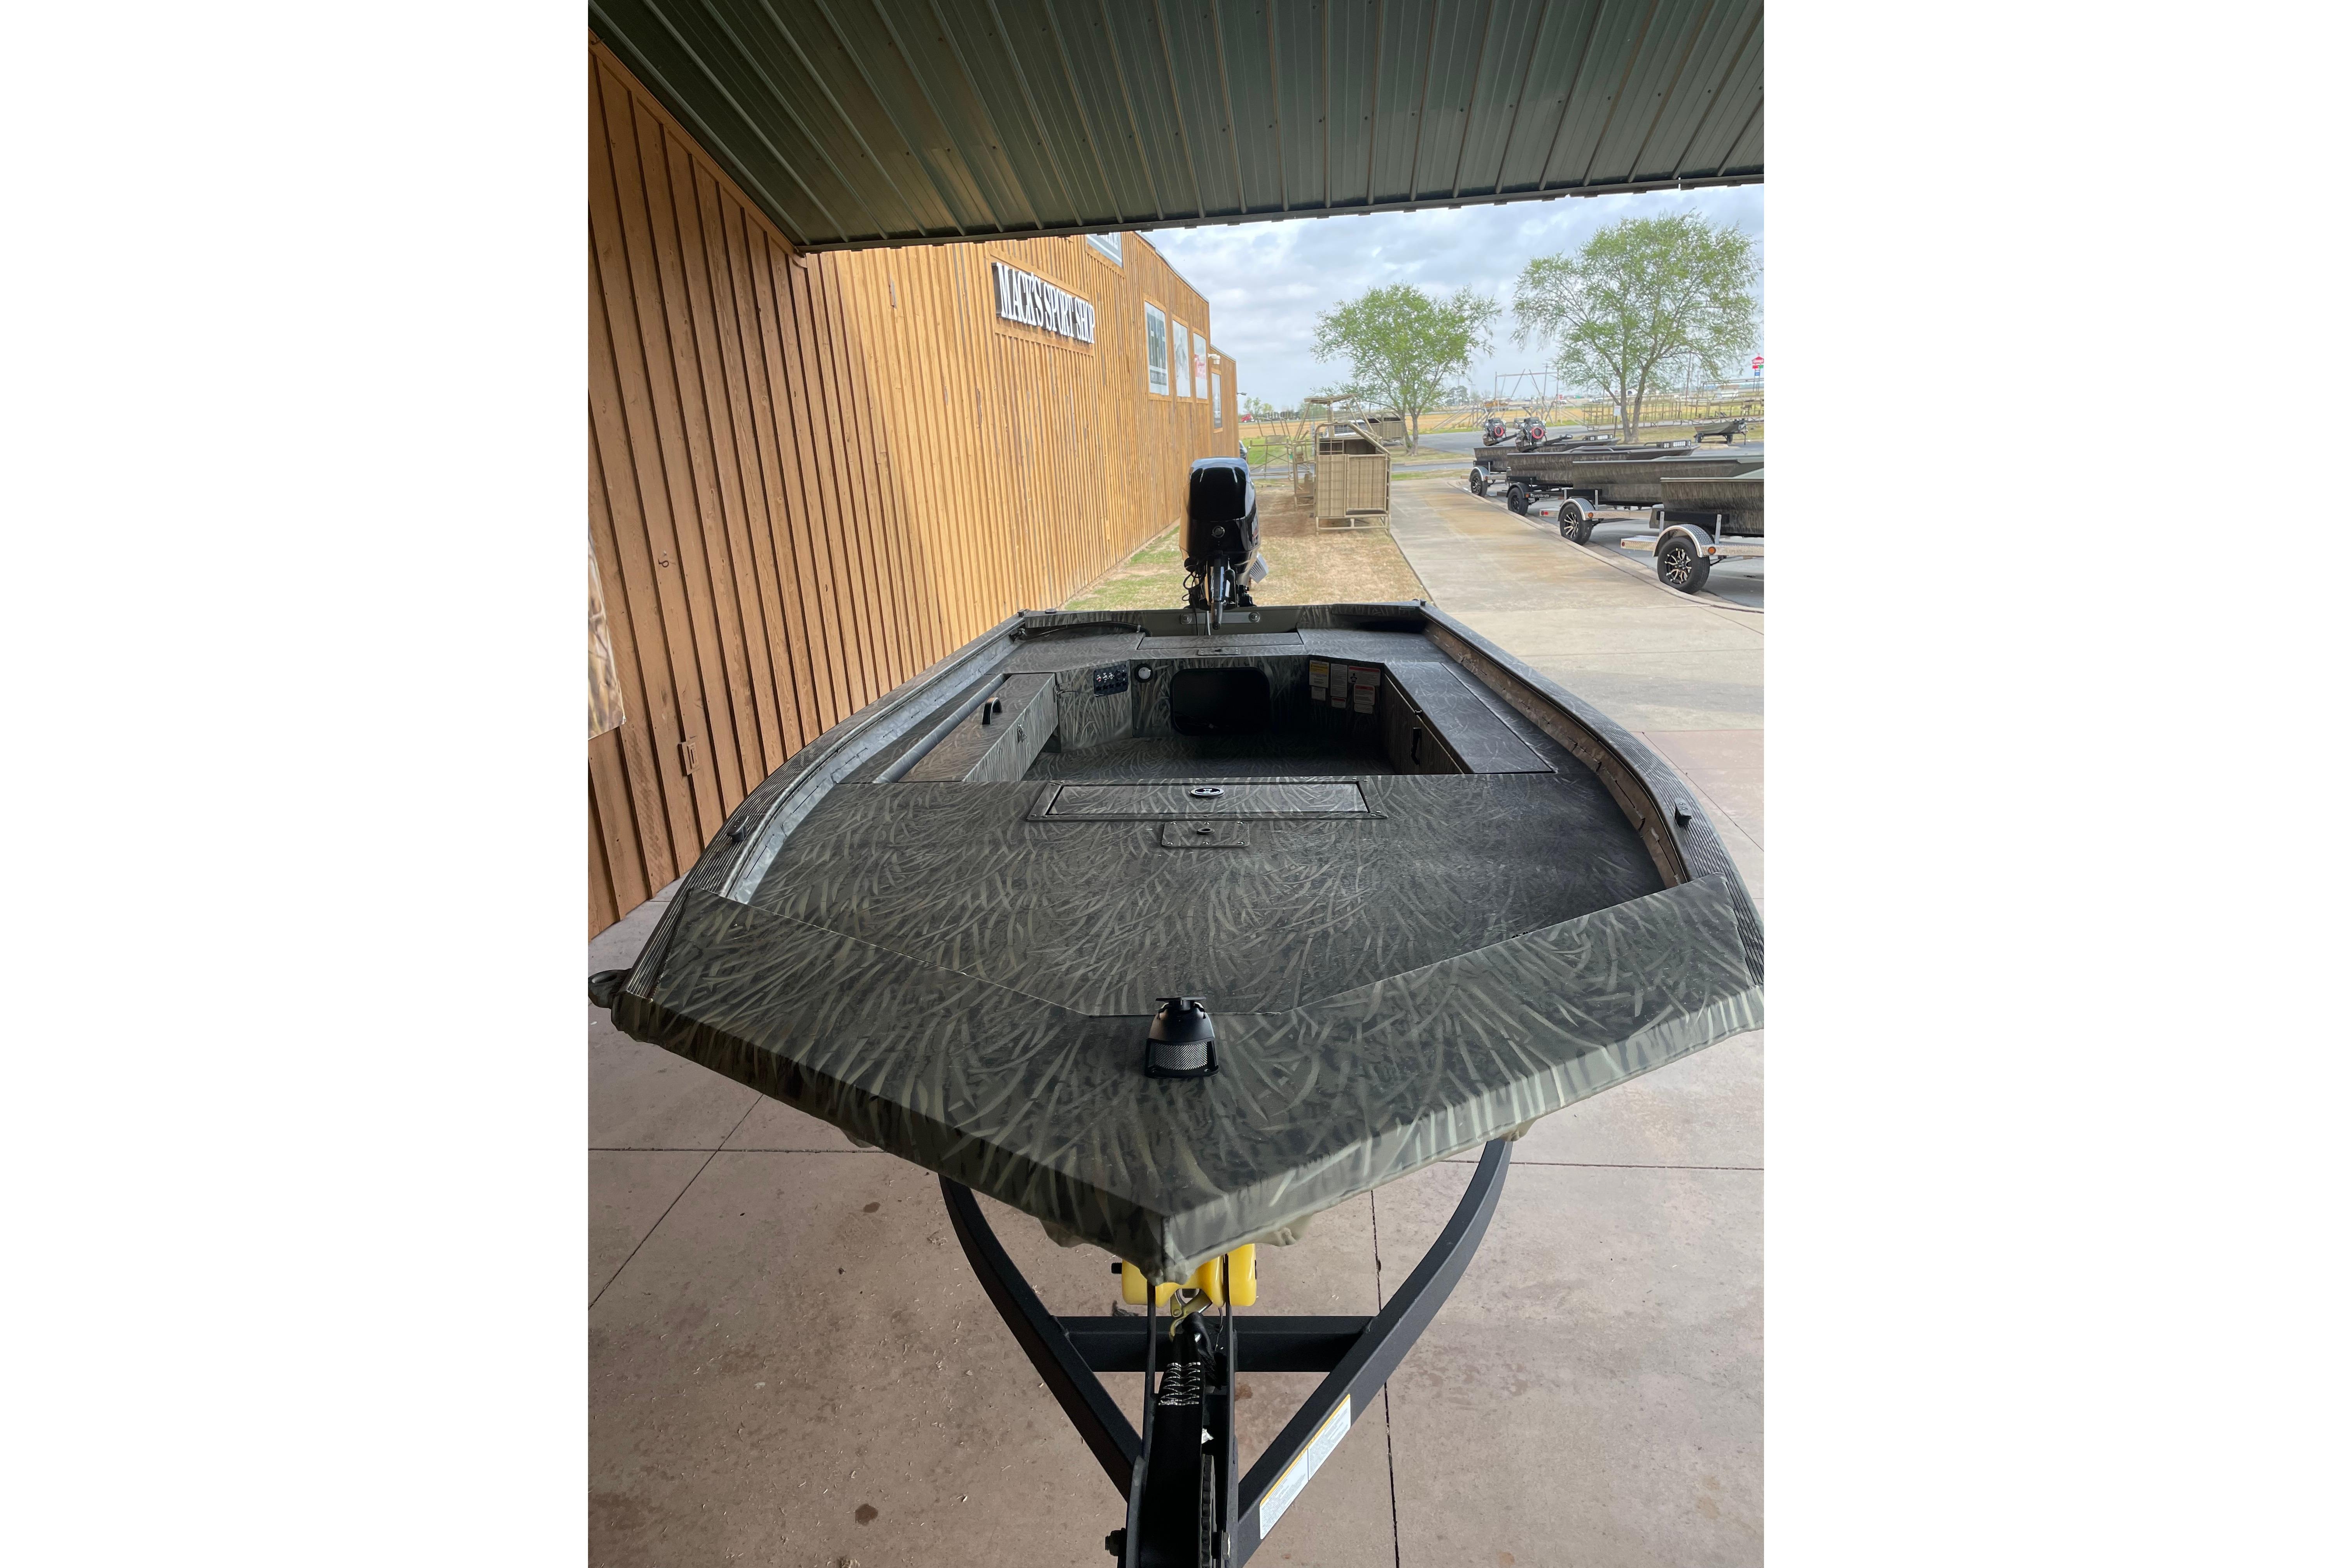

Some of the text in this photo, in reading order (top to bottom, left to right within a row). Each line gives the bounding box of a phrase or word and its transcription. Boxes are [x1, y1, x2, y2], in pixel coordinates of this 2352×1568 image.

[996, 262, 1095, 344] MACK'S SPORT SHOP
